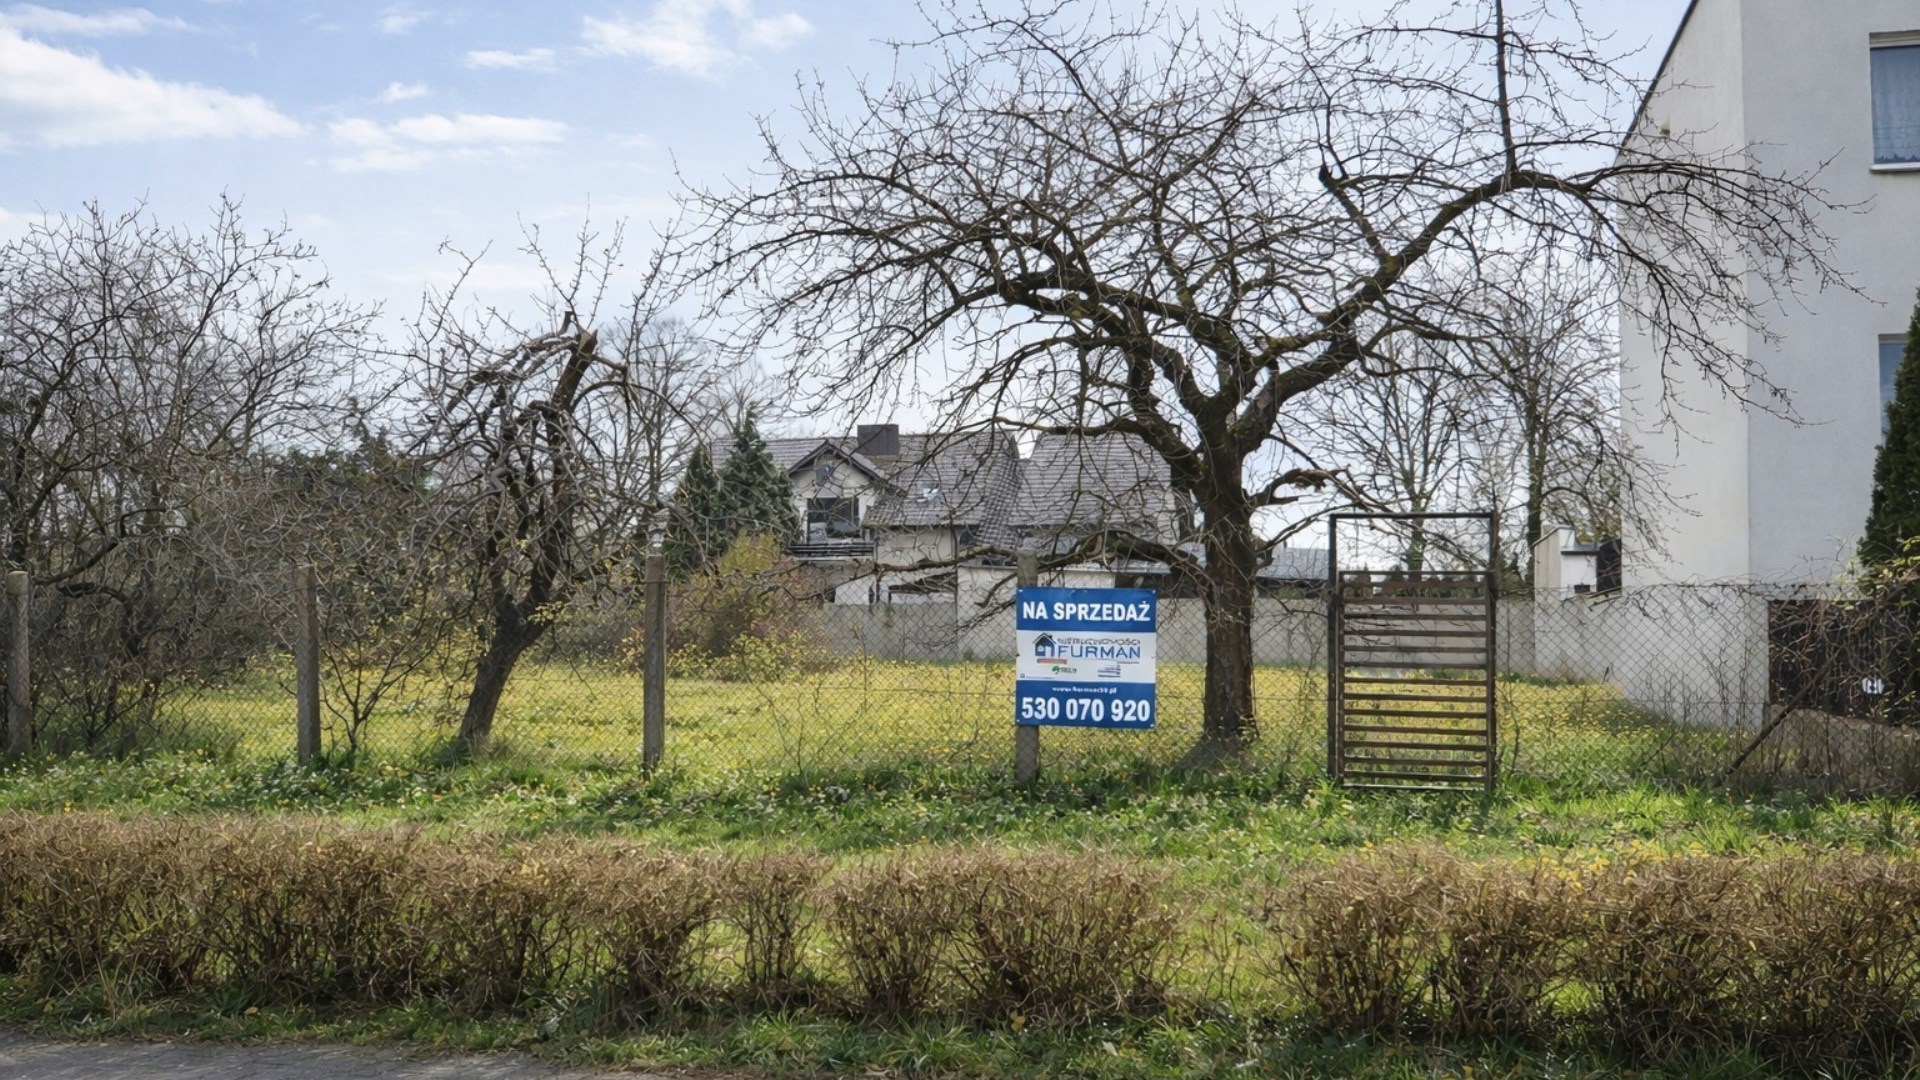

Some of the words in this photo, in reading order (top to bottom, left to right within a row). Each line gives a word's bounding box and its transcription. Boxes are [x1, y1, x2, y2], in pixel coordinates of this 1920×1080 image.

[1022, 601, 1048, 620] NA
[1053, 601, 1151, 621] SPRZEDAŻ
[1058, 645, 1141, 659] FURMAN
[1021, 696, 1060, 720] 530
[1065, 698, 1105, 722] 070
[1110, 699, 1151, 722] 920
